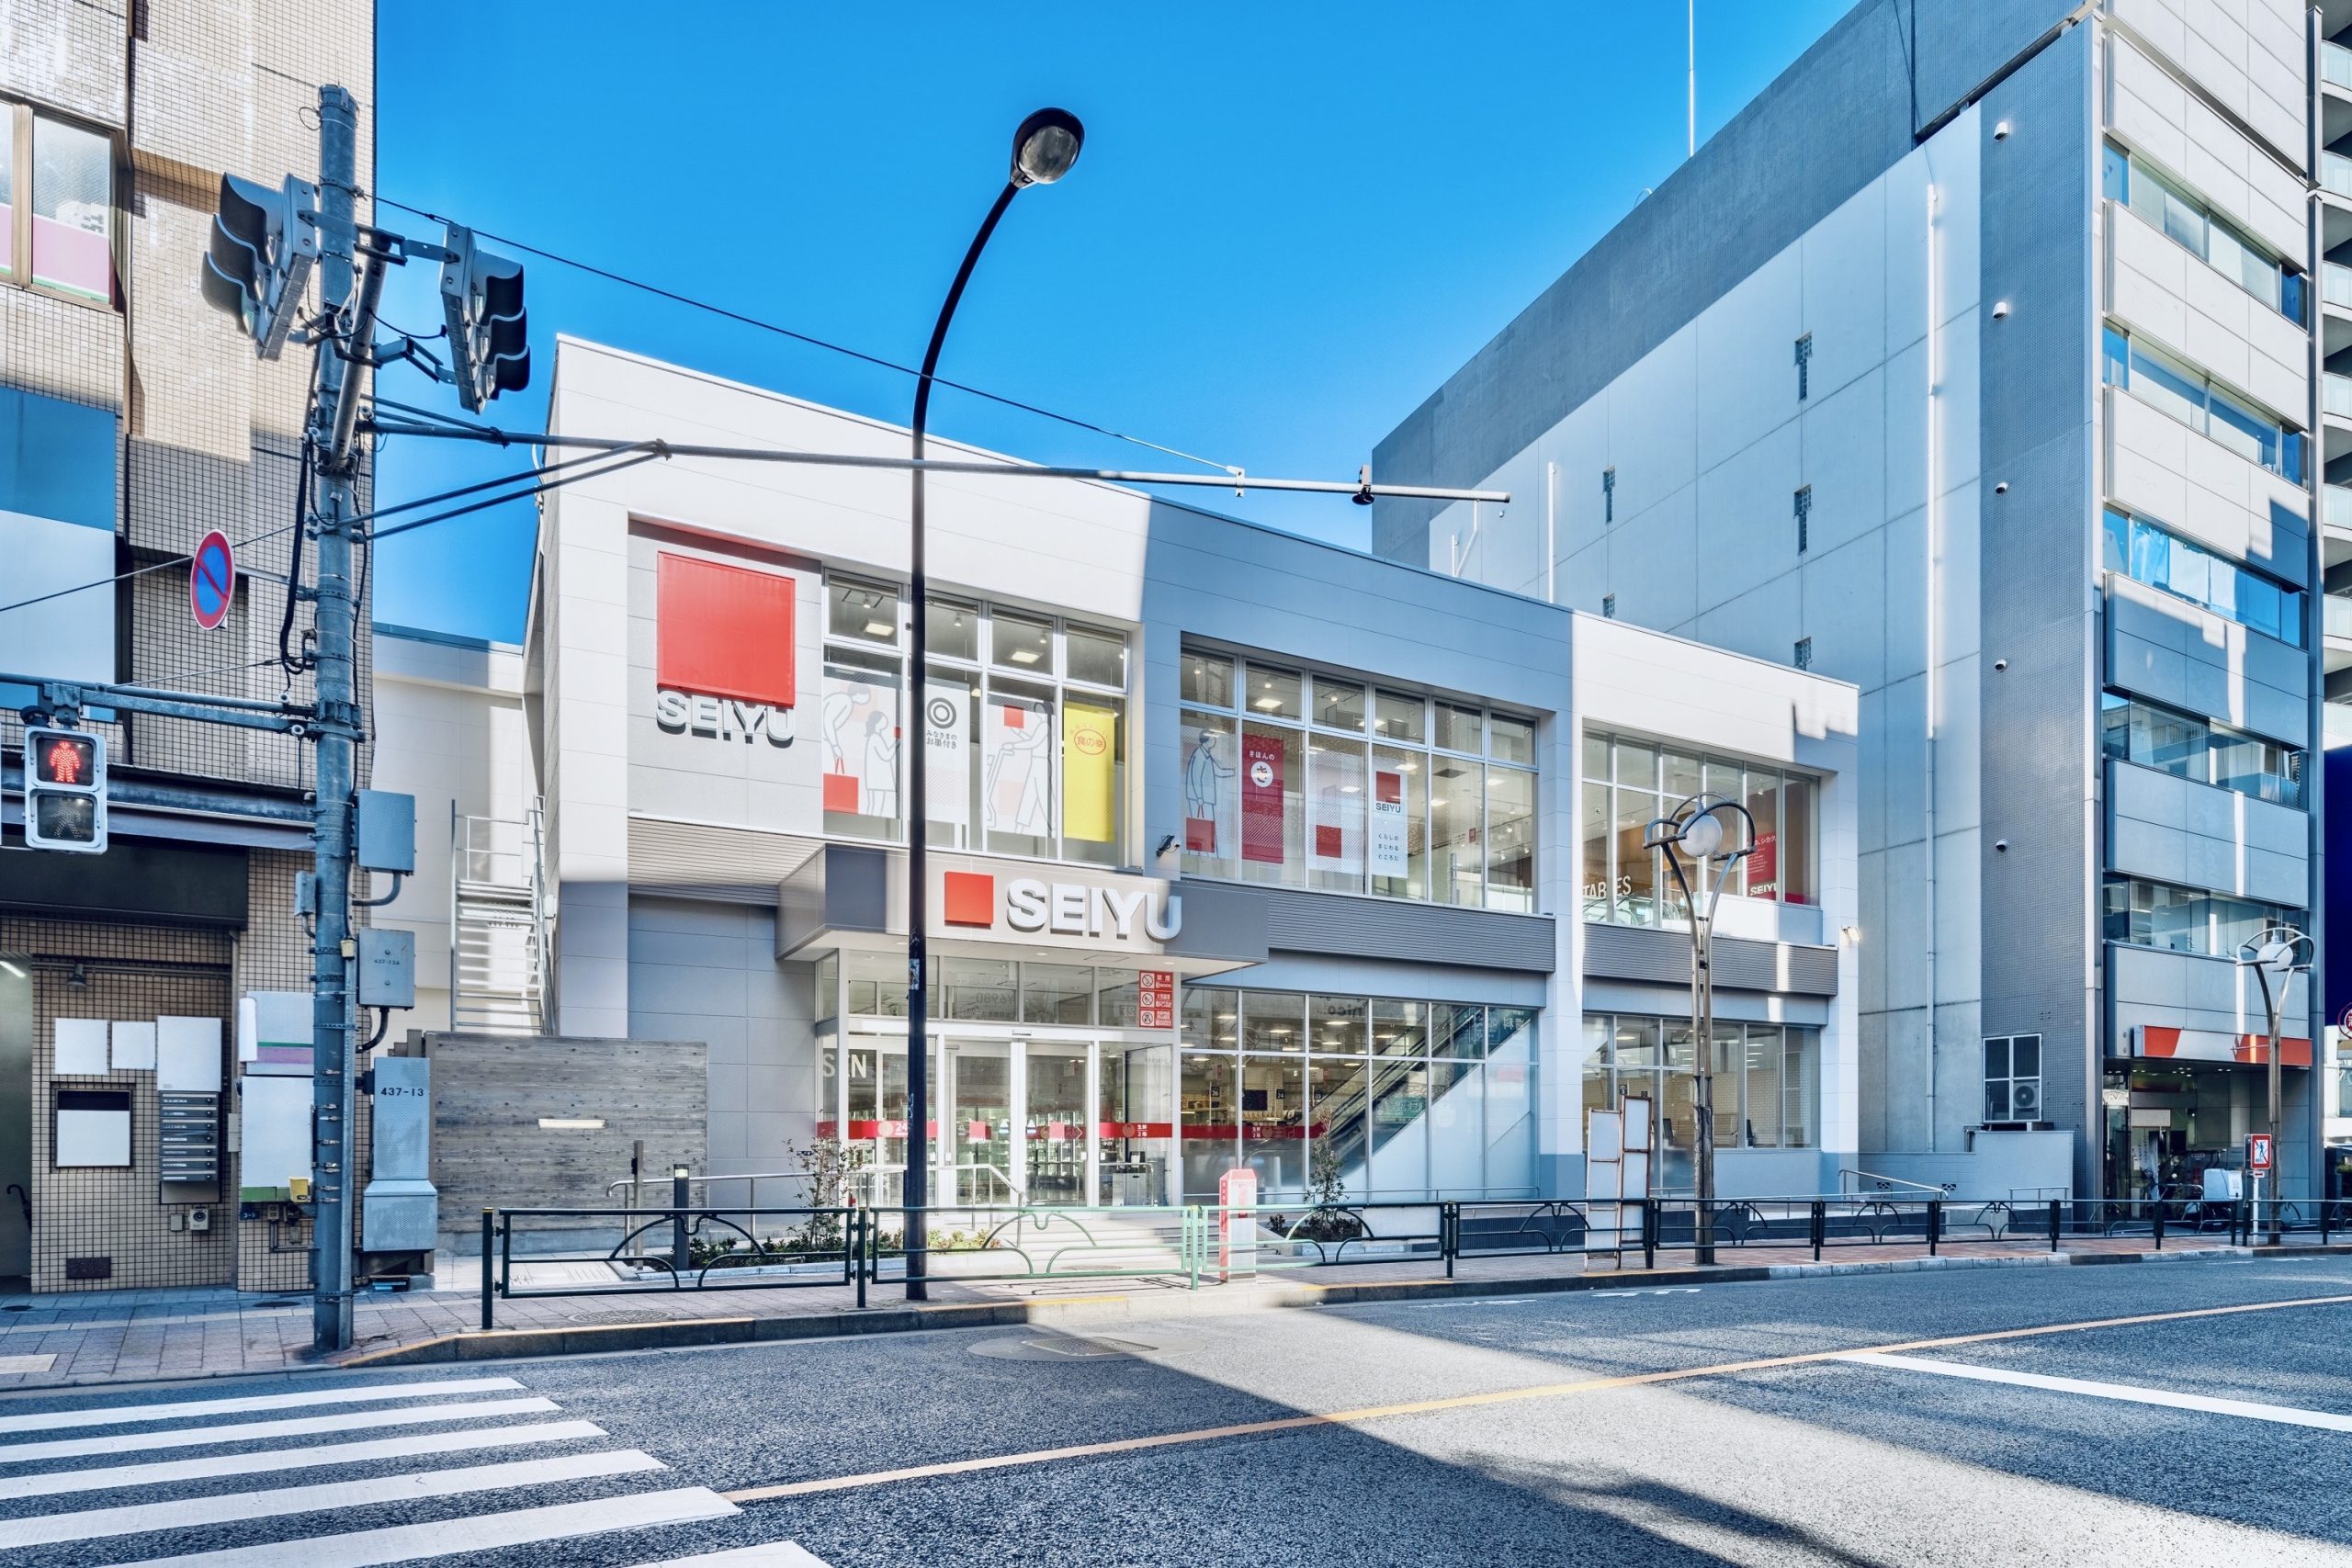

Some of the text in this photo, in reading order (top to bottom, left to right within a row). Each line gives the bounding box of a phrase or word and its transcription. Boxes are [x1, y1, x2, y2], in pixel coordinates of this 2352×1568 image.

[656, 690, 796, 743] SEIYU
[926, 729, 957, 740] みなさまの
[1249, 750, 1275, 761] きほんの
[1375, 802, 1401, 814] SEIYU
[1582, 874, 1632, 898] TABES
[1007, 878, 1182, 940] SEIYU
[823, 1053, 867, 1078] SN
[380, 1087, 424, 1098] 437-13
